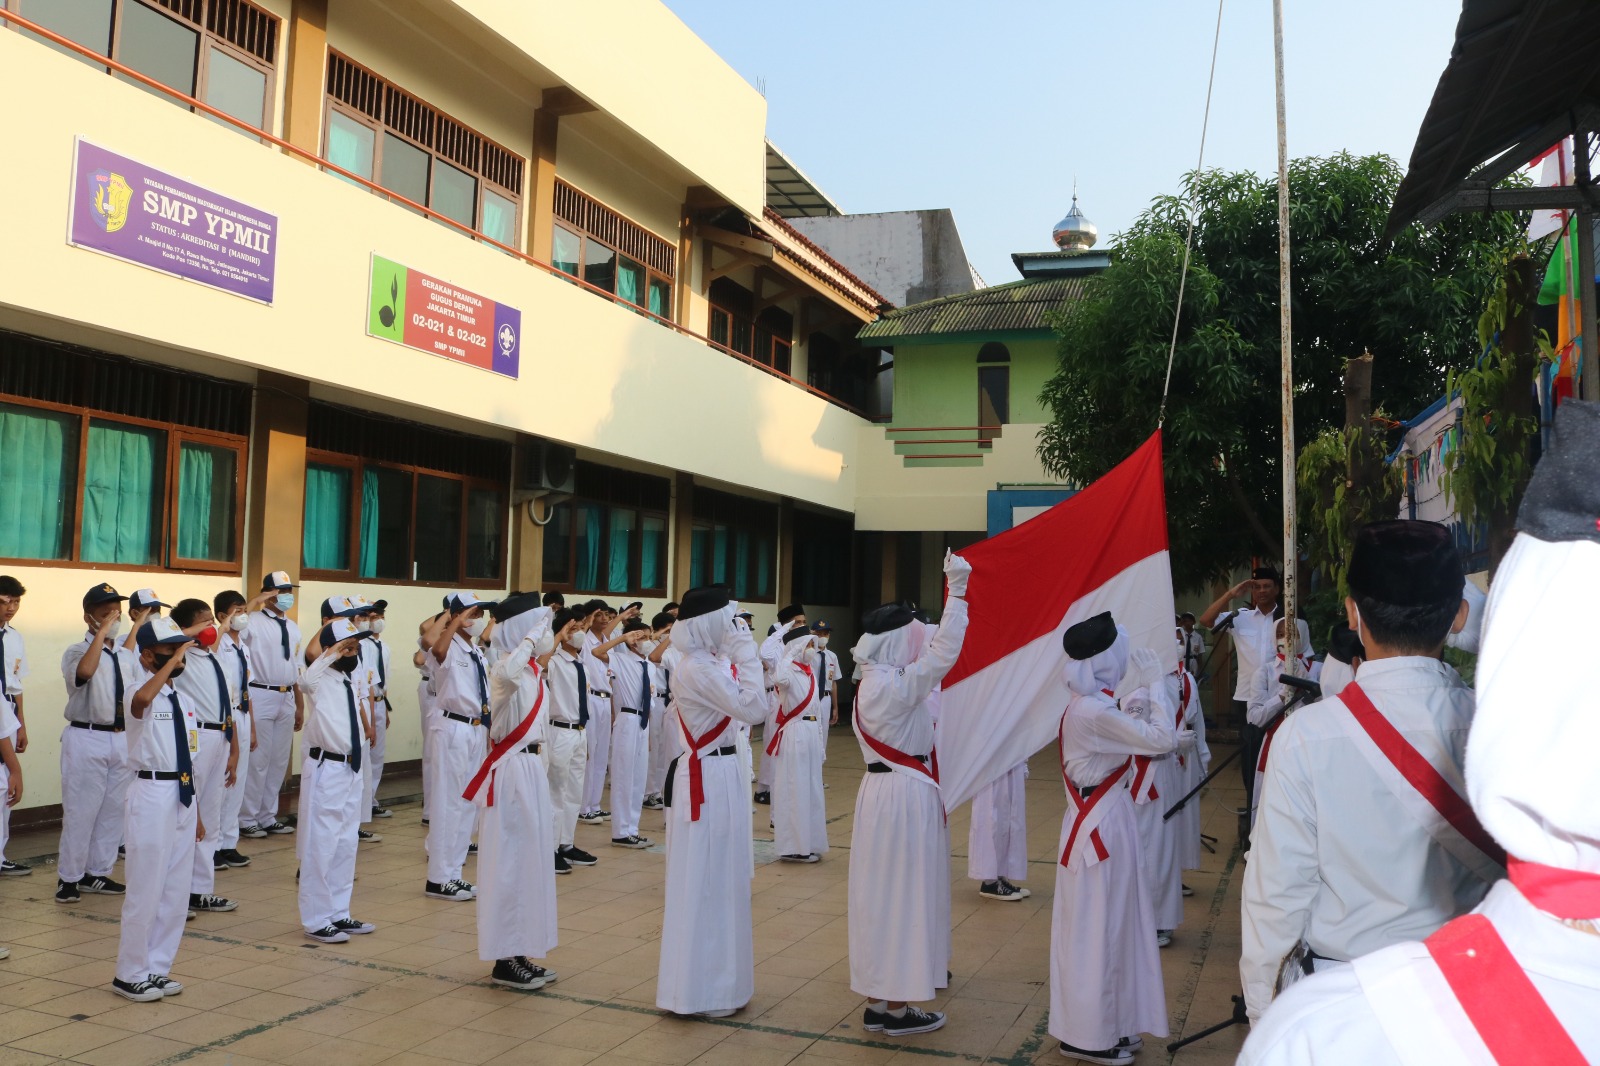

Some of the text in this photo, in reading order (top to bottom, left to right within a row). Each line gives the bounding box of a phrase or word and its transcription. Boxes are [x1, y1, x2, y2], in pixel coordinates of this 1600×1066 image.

[143, 190, 270, 254] SMP YPMII
[151, 222, 176, 236] STATUS
[180, 233, 219, 251] AKREDITASI
[228, 249, 260, 266] (MANDIRI)
[422, 279, 482, 308] GERAKAN PRAMUKA
[430, 293, 473, 314] GUGUS DEPAN
[427, 303, 476, 325] JAKARTA TIMUR
[412, 314, 486, 348] 02-021 & 02-022
[434, 341, 465, 357] SMP YPMII
